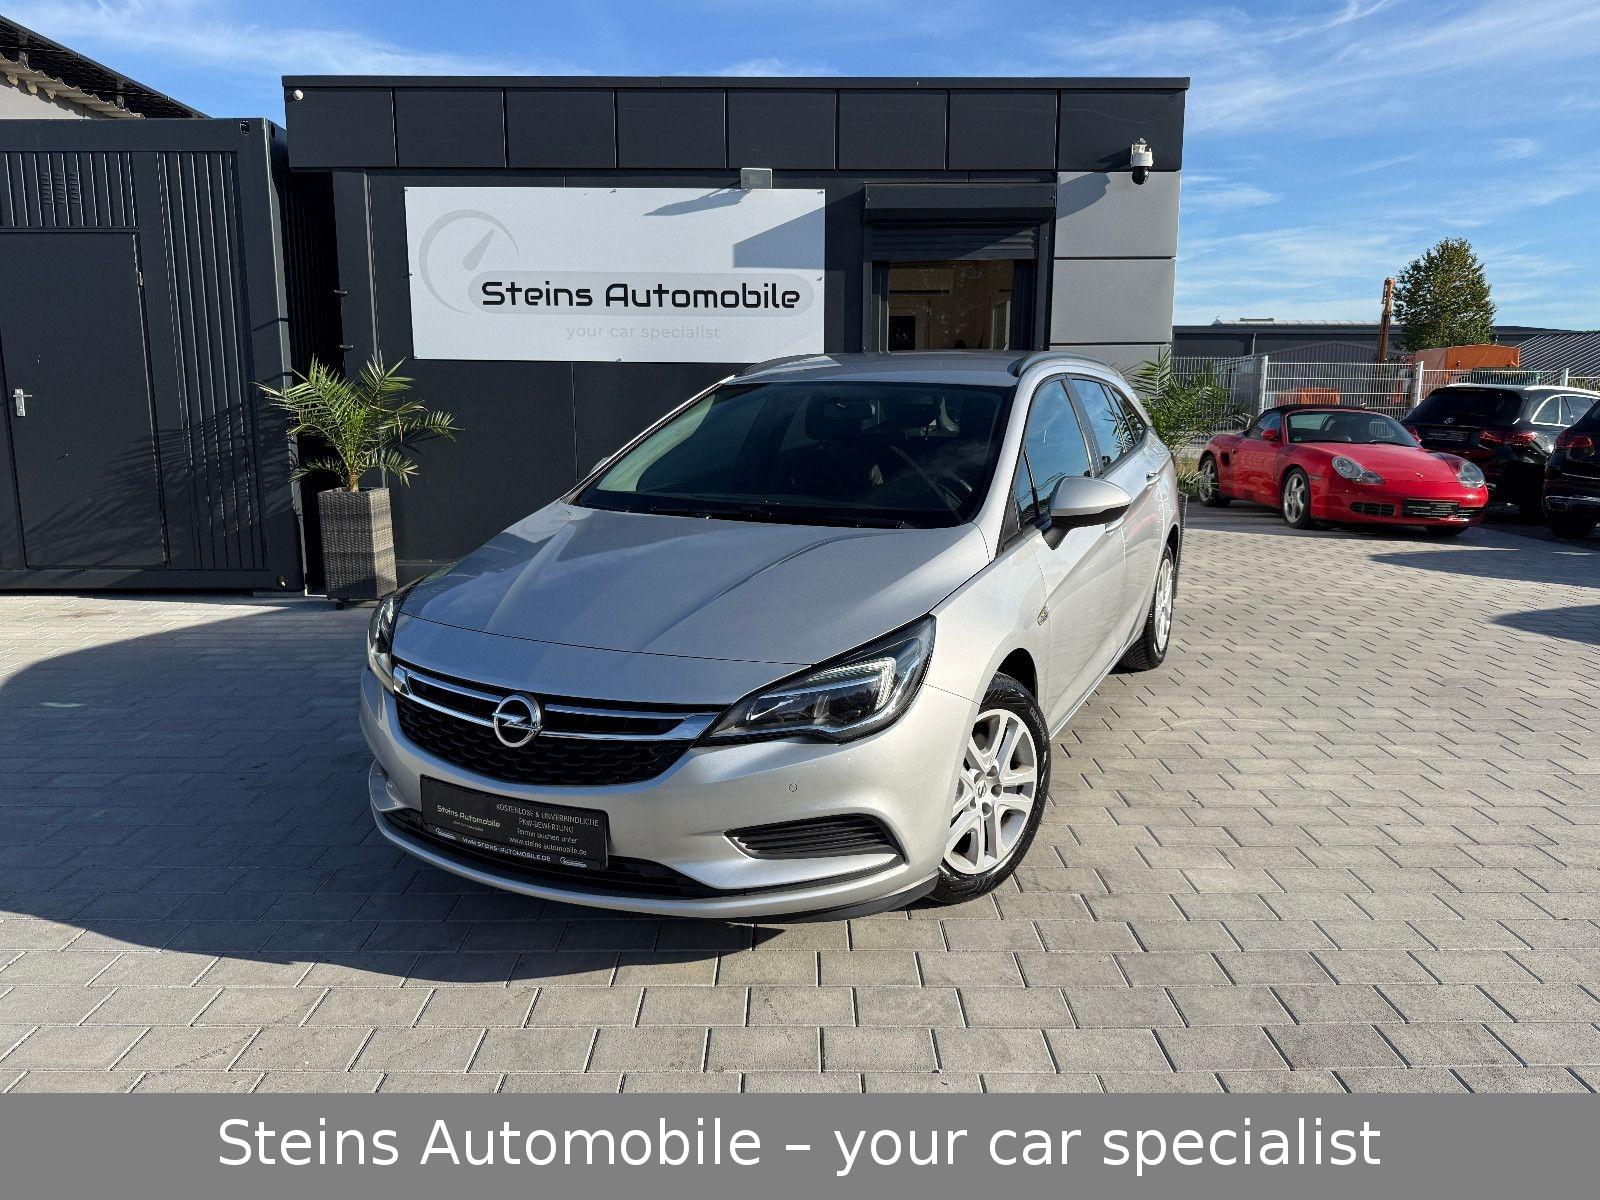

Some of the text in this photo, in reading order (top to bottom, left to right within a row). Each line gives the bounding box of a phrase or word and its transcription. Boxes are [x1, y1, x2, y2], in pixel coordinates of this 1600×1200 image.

[481, 280, 801, 310] Steins Automobile
[566, 324, 721, 341] your car specialist
[437, 804, 459, 817] Steins
[459, 812, 501, 828] Automobile
[496, 803, 534, 817] KOSTENLOSE
[541, 813, 599, 827] UNVERBINDLICHE
